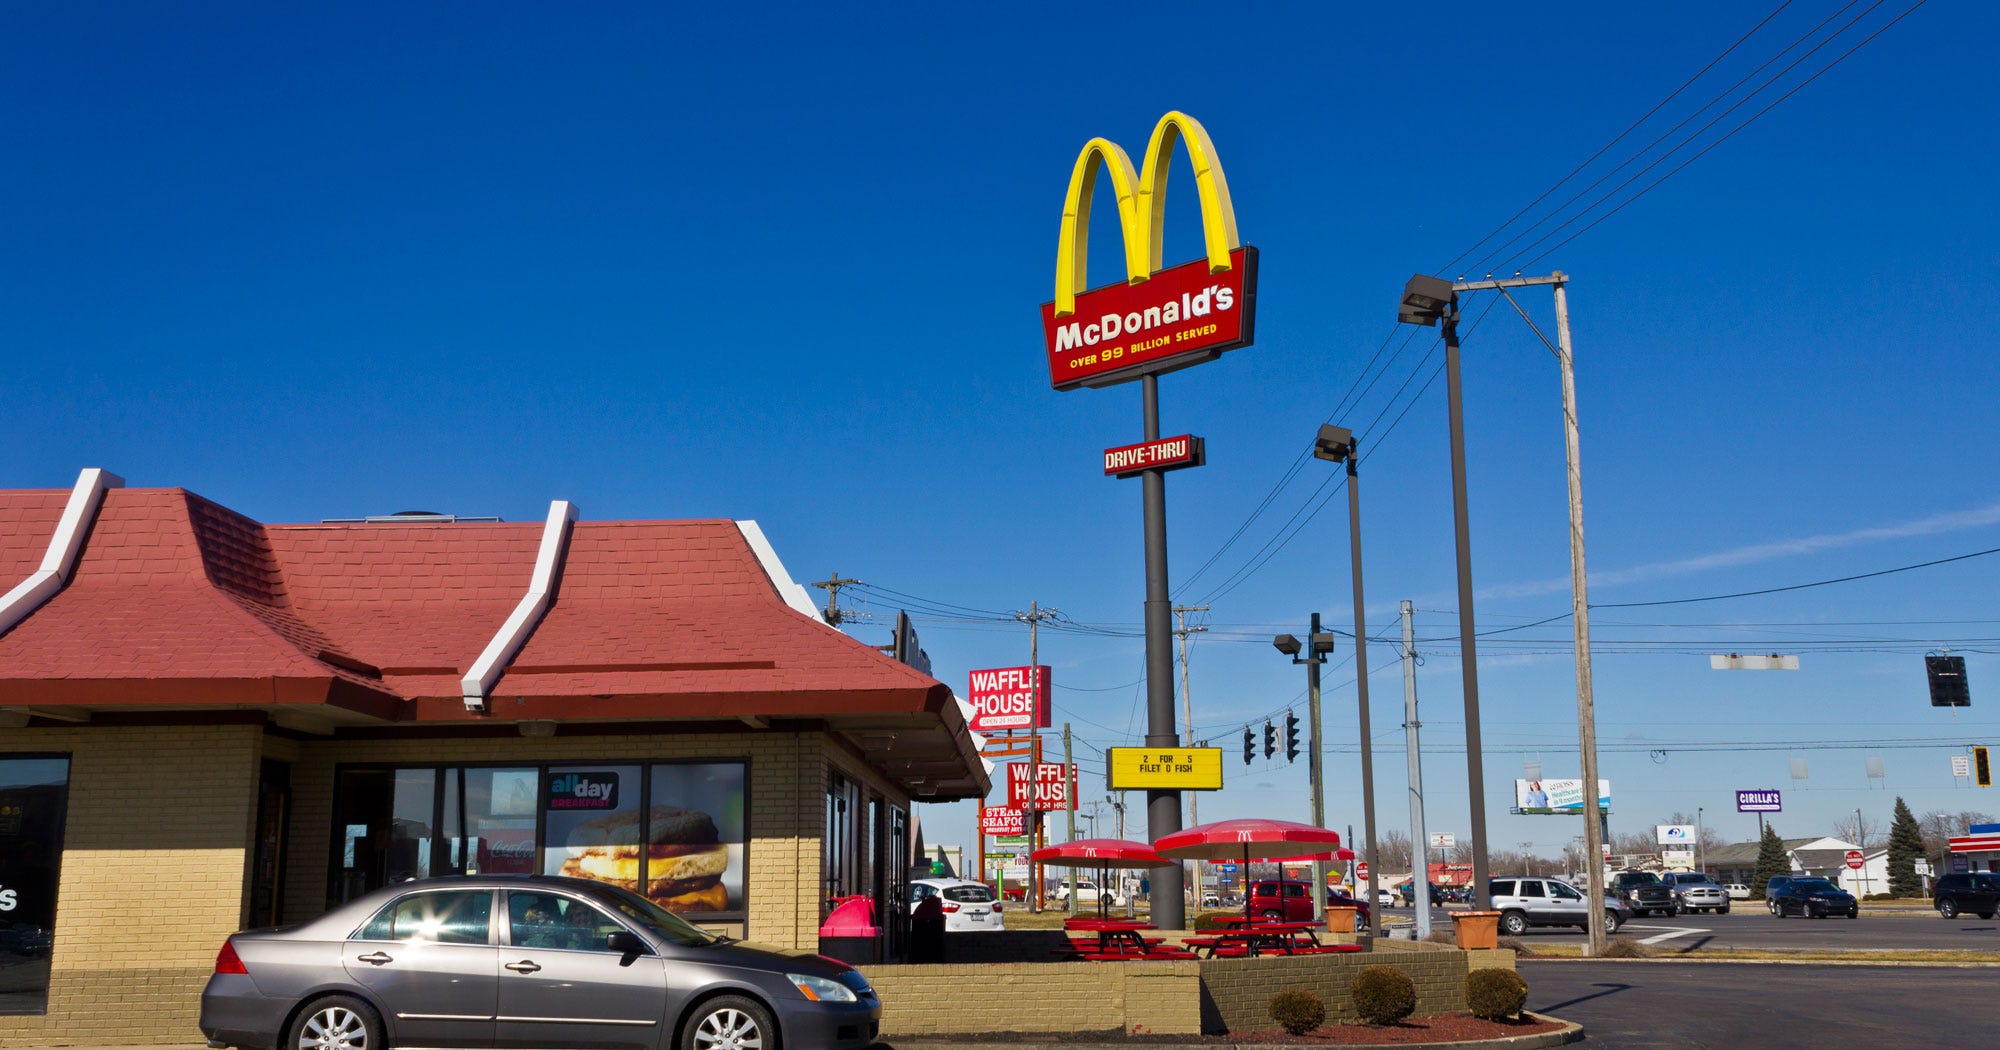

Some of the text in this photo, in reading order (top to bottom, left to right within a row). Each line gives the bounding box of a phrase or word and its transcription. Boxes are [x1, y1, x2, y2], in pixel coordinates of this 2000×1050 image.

[1055, 285, 1234, 352] McDonald's
[1070, 324, 1217, 369] OVER 99 BILLION SERVED
[1105, 440, 1186, 469] DRIVE-THRU
[971, 669, 1040, 692] WAFFLE
[974, 692, 1032, 714] HOUSE
[1140, 764, 1161, 773] FILET
[1175, 764, 1193, 773] FISH
[1144, 755, 1192, 763] 2 FOR 5
[551, 774, 613, 800] all day
[1015, 783, 1067, 800] HOUS
[1740, 793, 1779, 803] CIRILLA'S
[551, 799, 610, 807] BREAKFAST
